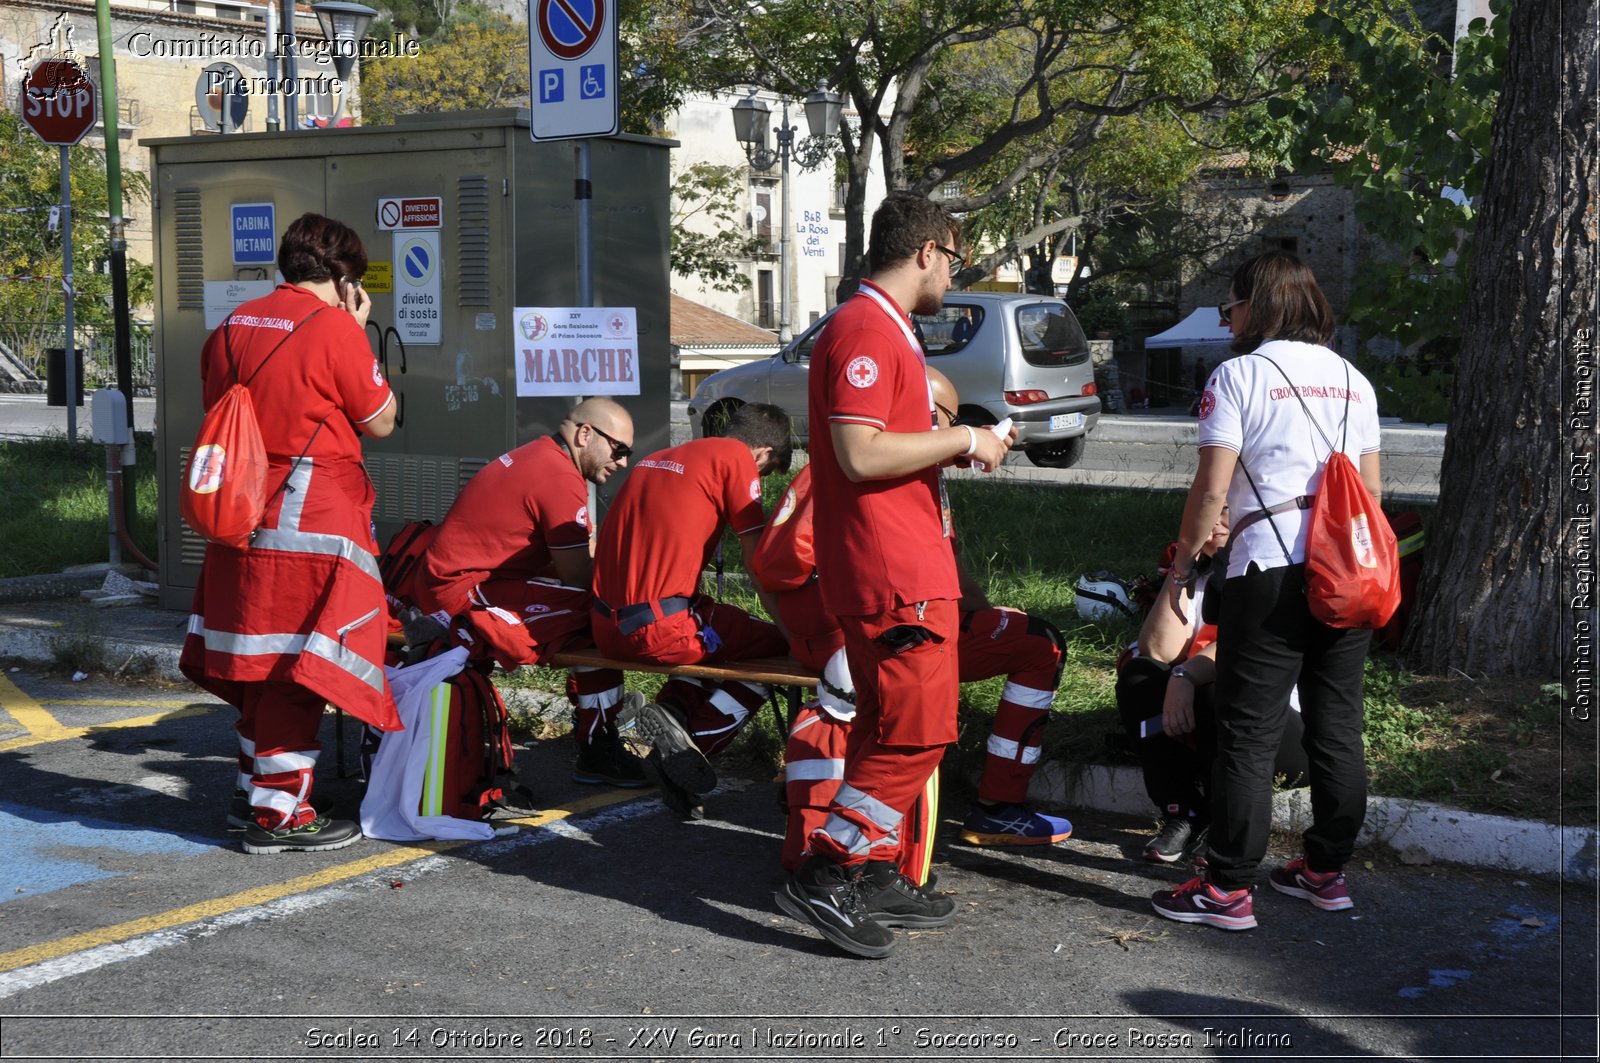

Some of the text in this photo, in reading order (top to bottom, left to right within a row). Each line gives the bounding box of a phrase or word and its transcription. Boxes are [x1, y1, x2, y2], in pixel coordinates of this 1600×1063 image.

[544, 73, 559, 100] P
[27, 86, 90, 118] STOP
[405, 204, 428, 212] DIVIETO
[404, 214, 438, 222] AFFISSIONE
[804, 210, 821, 222] B&B
[236, 216, 270, 231] CABINA
[796, 222, 828, 234] La Rosa
[235, 237, 272, 252] METANO
[806, 235, 820, 245] dei
[802, 246, 825, 257] Venti
[402, 293, 434, 305] divieto
[398, 308, 438, 320] di sosta
[522, 348, 634, 383] MARCHE
[1301, 386, 1328, 398] ROSSA
[1329, 386, 1362, 404] ITALANA
